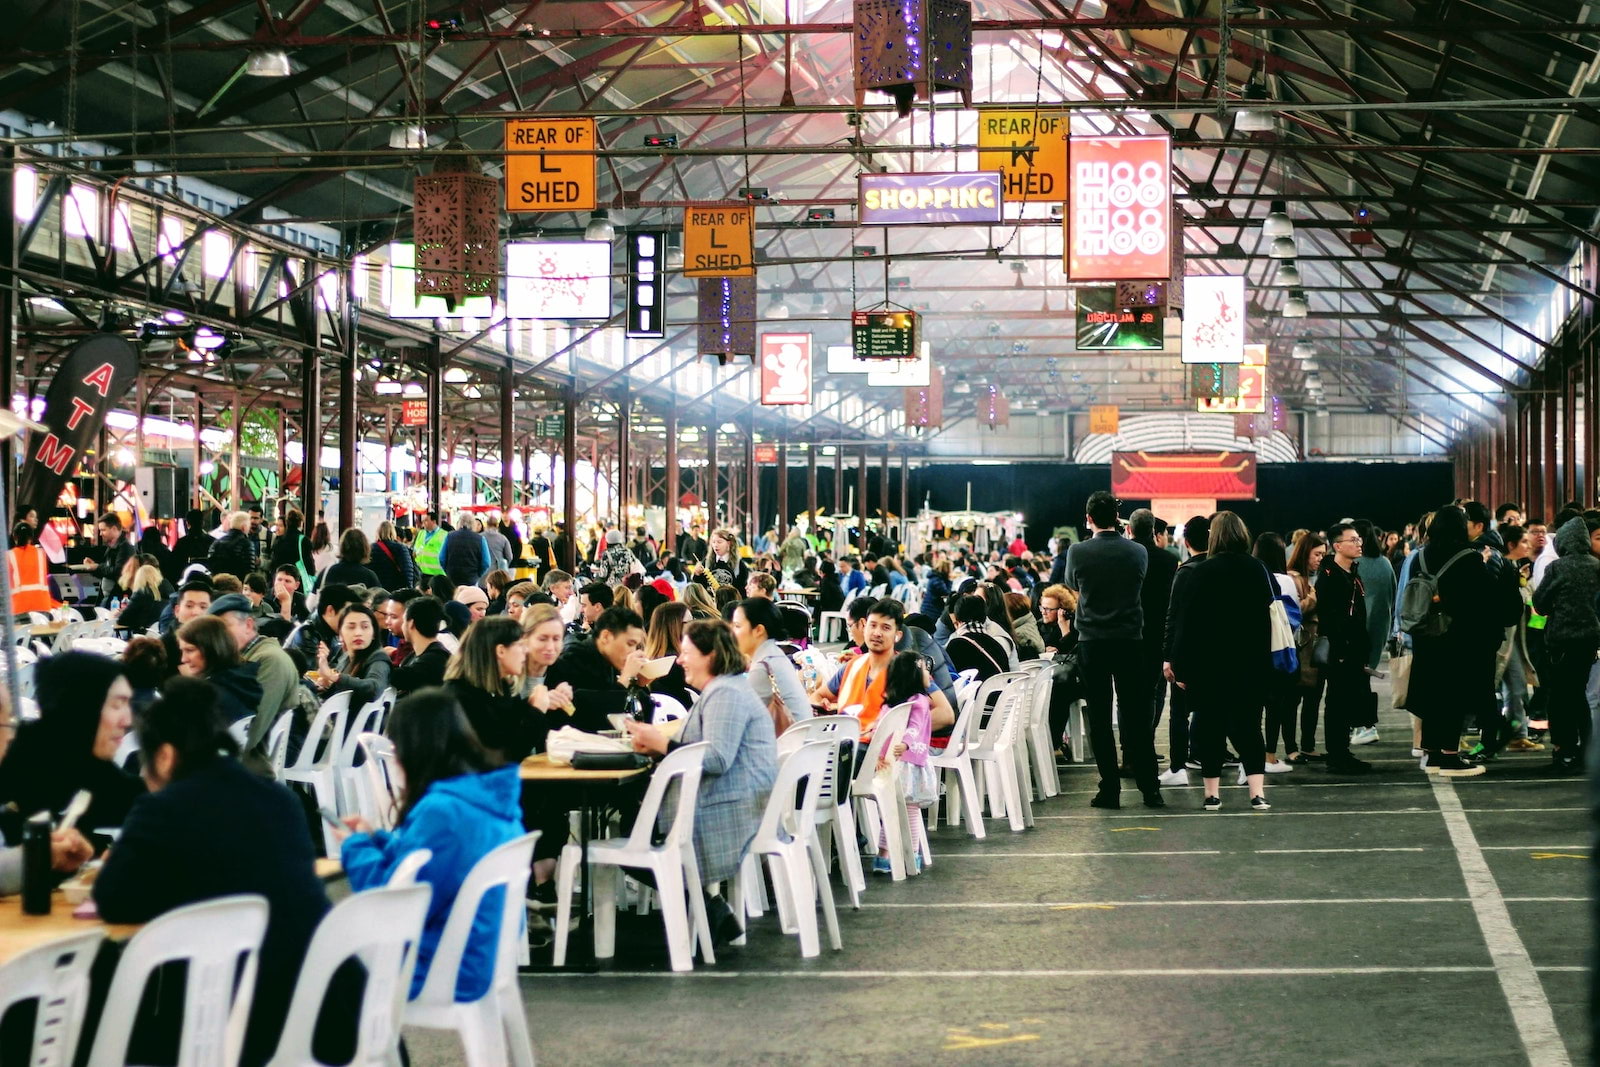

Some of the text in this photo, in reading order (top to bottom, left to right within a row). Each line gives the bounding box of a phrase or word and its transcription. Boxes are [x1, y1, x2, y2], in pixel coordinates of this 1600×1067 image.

[516, 127, 584, 144] REAR OF
[988, 118, 1058, 134] REAR OF
[540, 147, 561, 172] L
[1011, 140, 1034, 166] K
[522, 182, 579, 204] SHED
[1004, 173, 1054, 194] HED
[865, 187, 996, 210] SHOPPING
[692, 212, 746, 226] REAR OF
[711, 228, 728, 248] L
[696, 254, 741, 271] SHED
[36, 362, 114, 476] ATM
